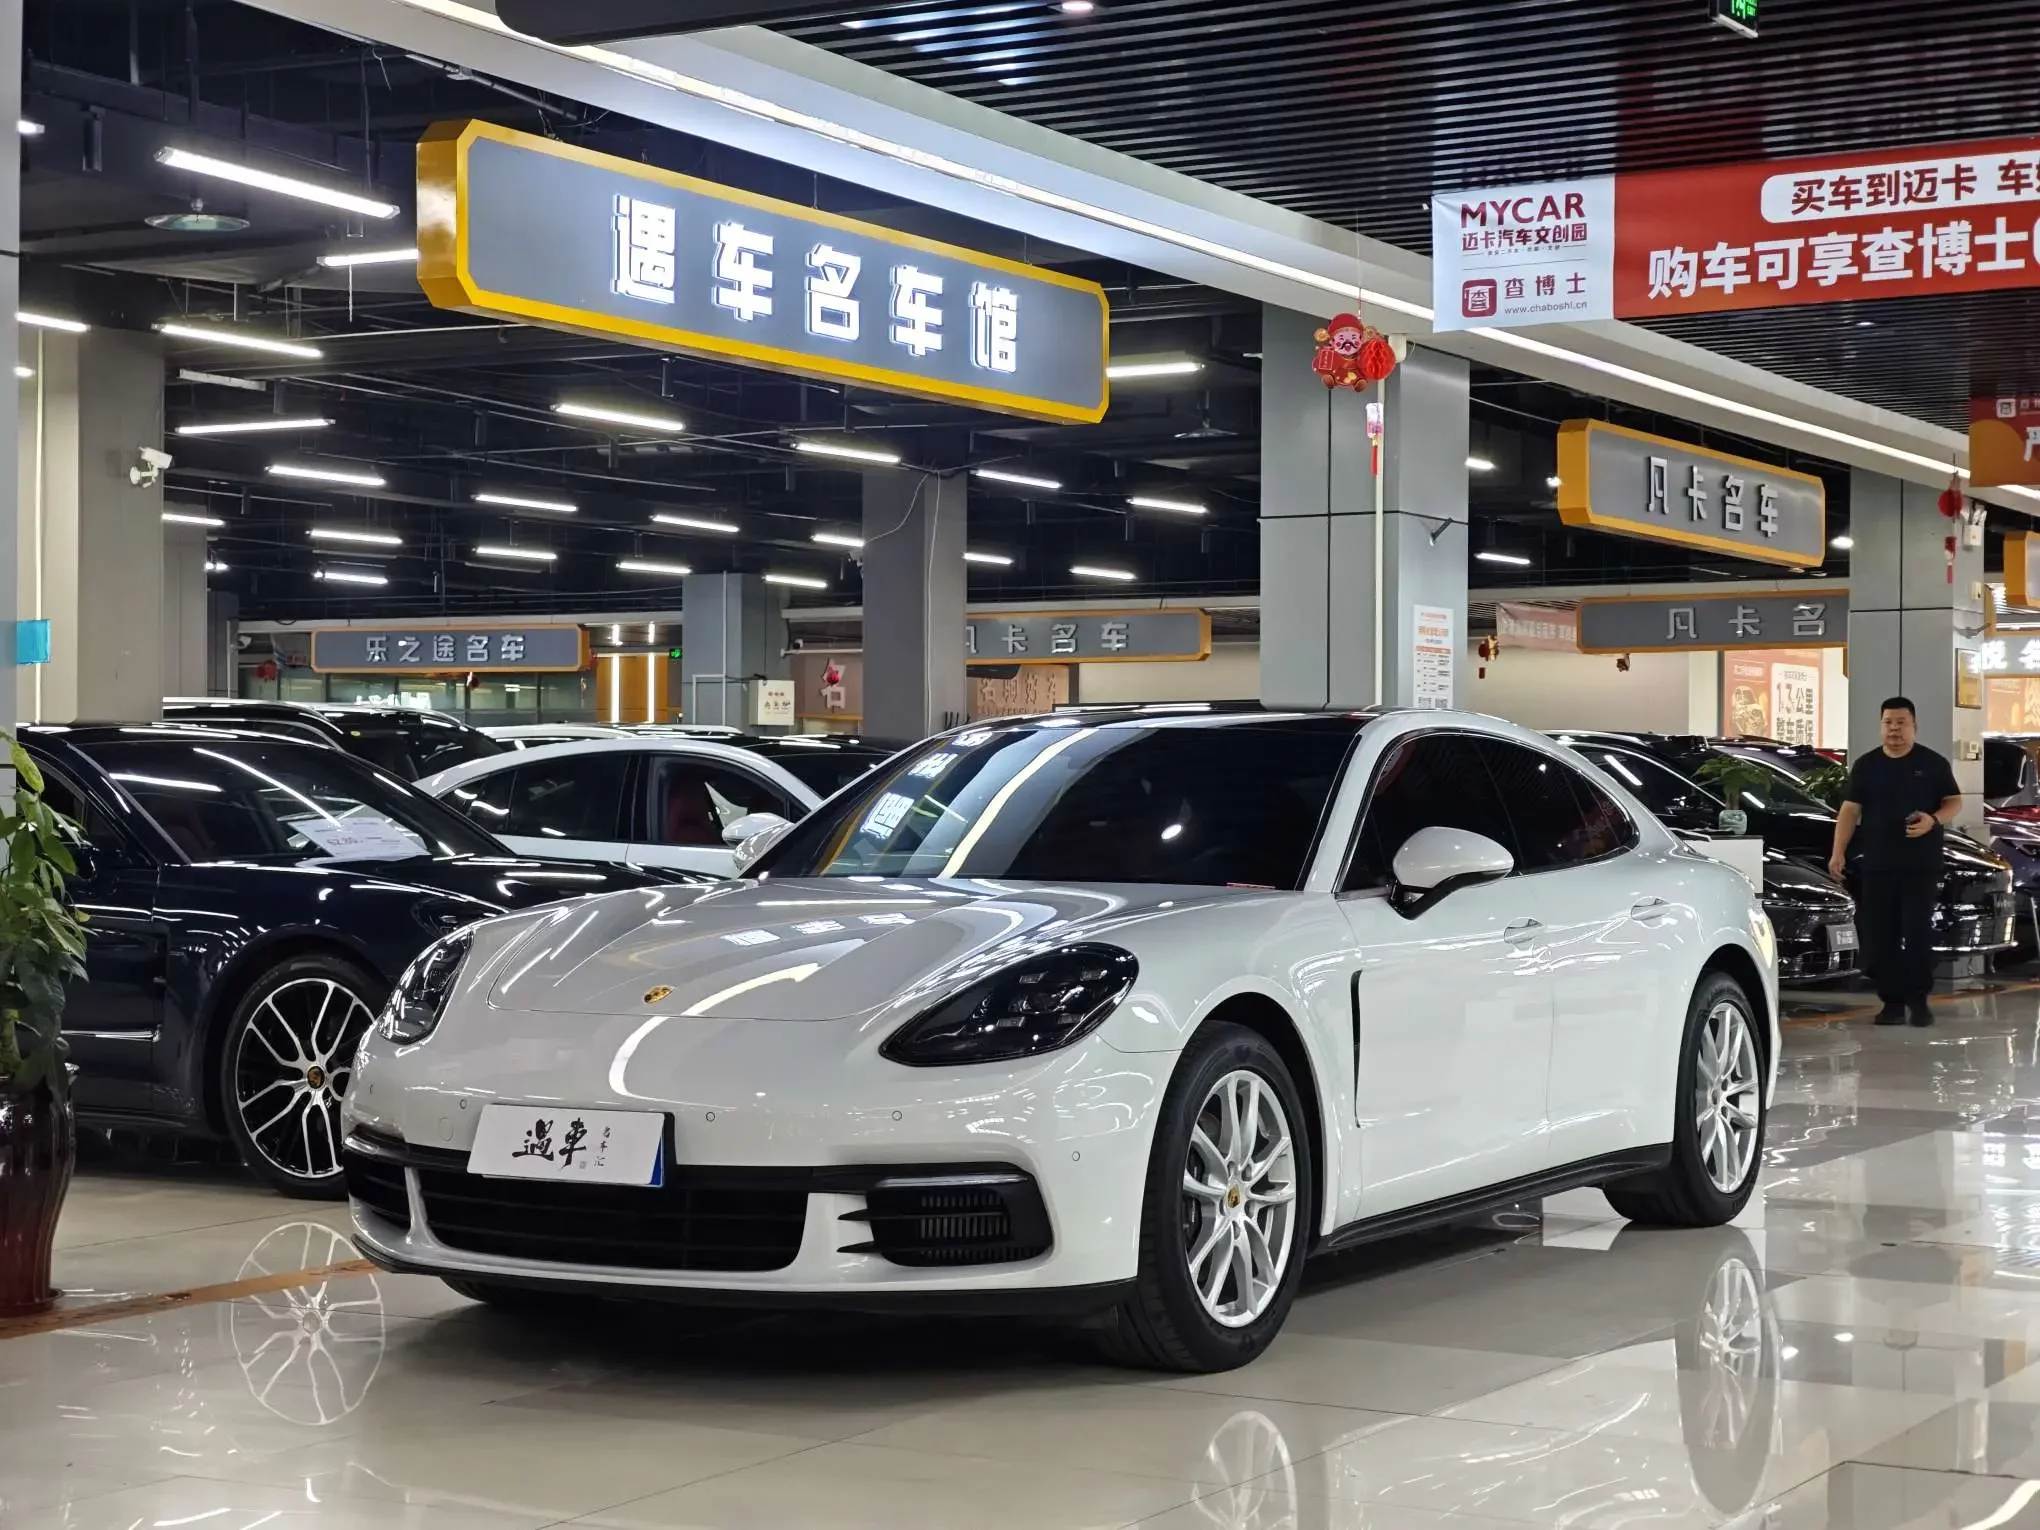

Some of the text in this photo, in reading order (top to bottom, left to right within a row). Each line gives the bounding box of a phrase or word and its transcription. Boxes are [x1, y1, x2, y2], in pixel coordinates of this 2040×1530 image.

[1791, 159, 2040, 215] 买车到迈卡 车
[1461, 193, 1586, 228] MYCAR
[1462, 223, 1587, 251] 迈卡汽车文创园
[1648, 217, 2029, 299] 购车可享查博士
[612, 193, 1018, 373] 遇车名车馆
[1504, 272, 1586, 299] 查博士
[1647, 456, 1778, 537] 凡卡名车
[1666, 603, 1826, 639] 凡卡名
[366, 634, 526, 662] 乐之途名车
